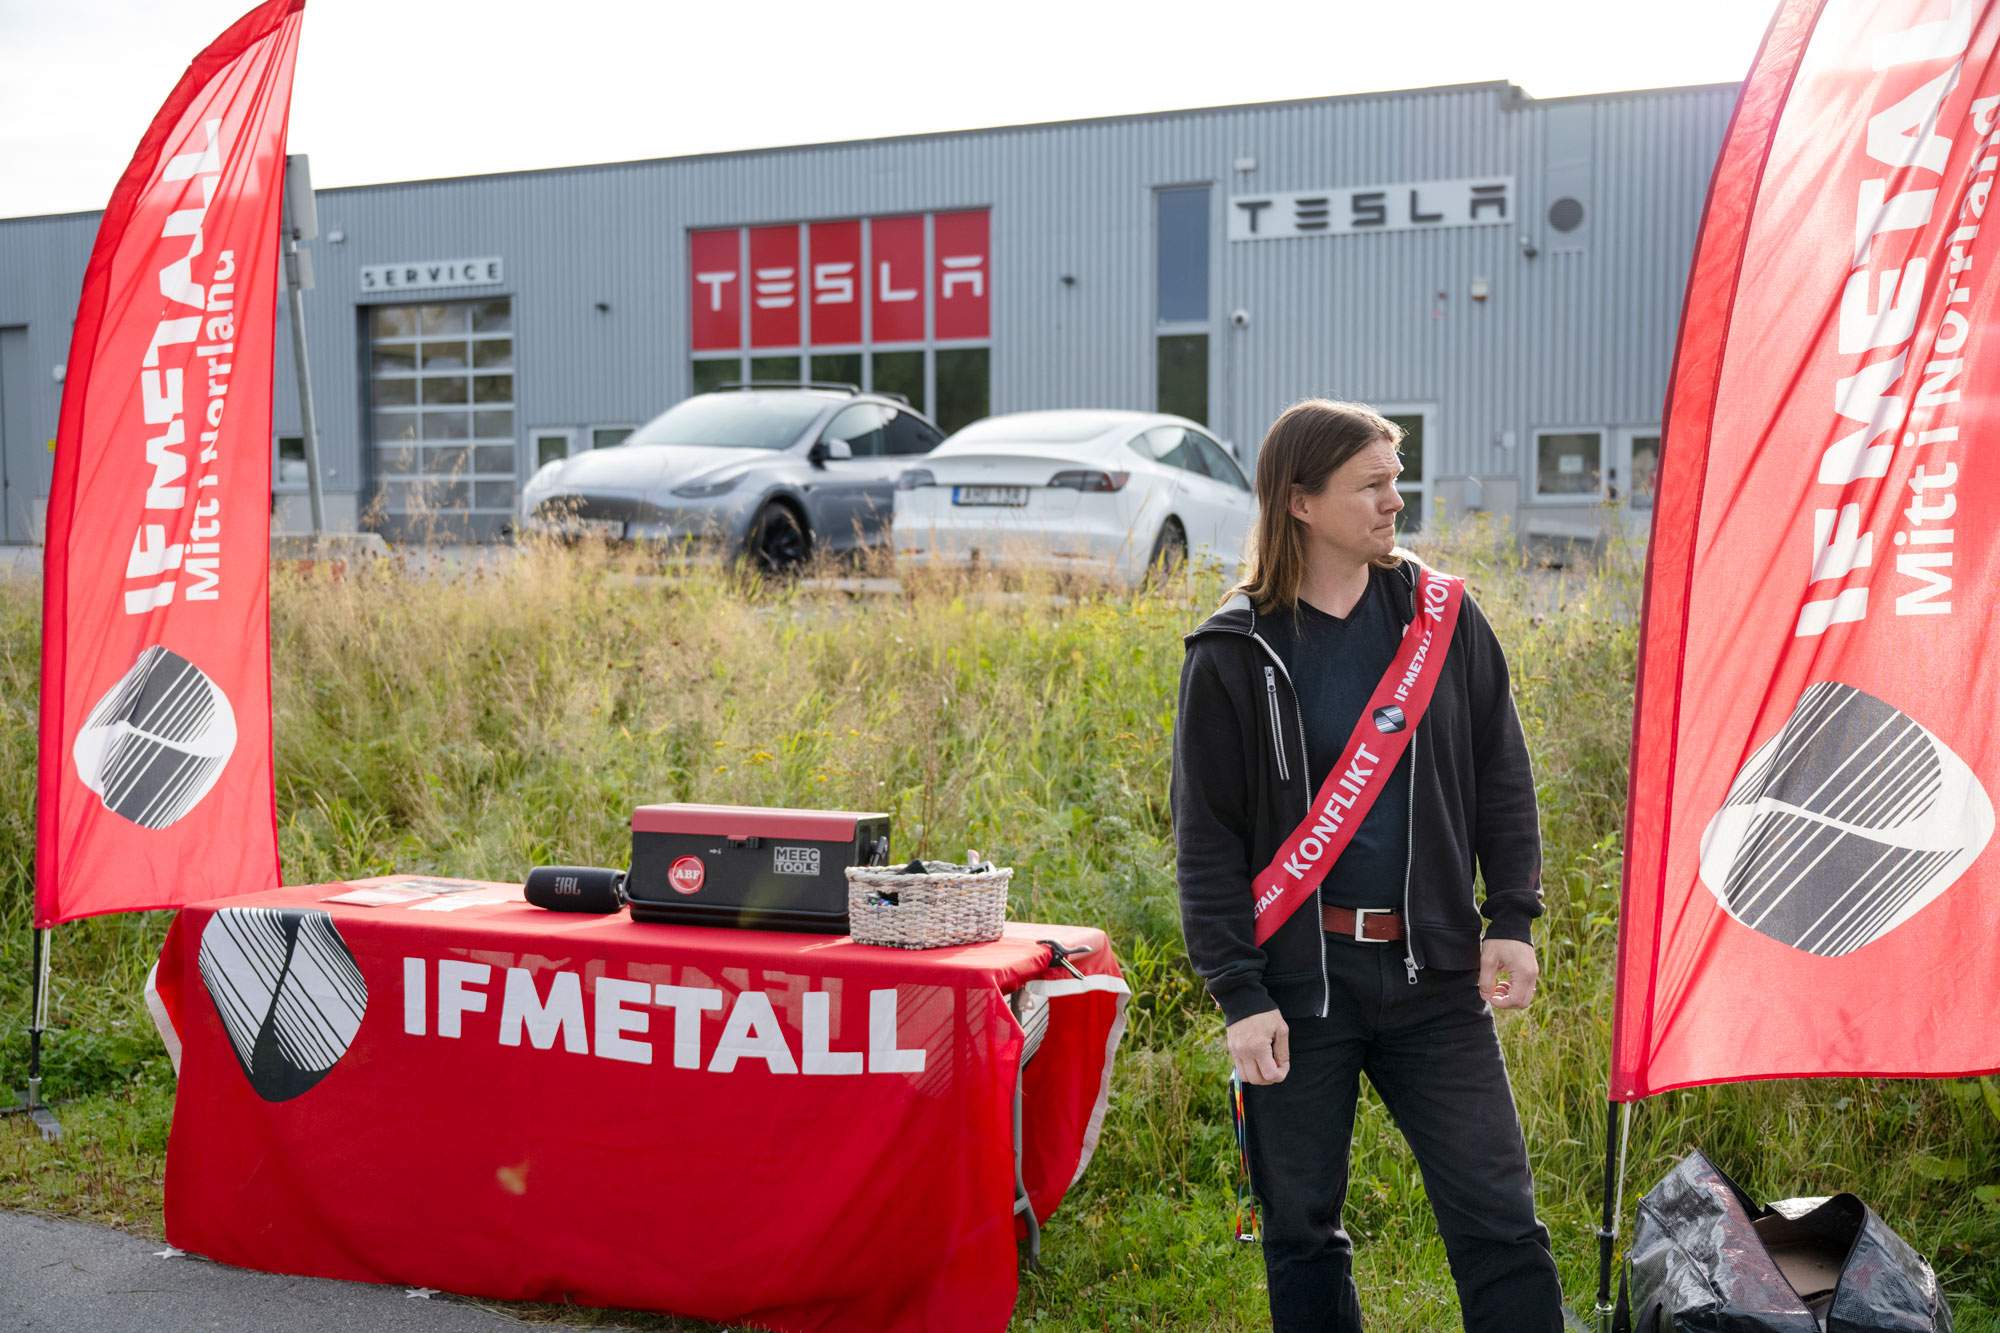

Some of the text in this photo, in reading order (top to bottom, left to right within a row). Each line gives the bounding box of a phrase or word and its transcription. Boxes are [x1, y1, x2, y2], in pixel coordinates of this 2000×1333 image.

[1236, 185, 1507, 233] TESLA
[364, 263, 498, 287] SERVICE
[696, 256, 984, 311] TESLA
[125, 118, 222, 615] IFMETALL
[1893, 94, 2000, 615] Mitt i Norrland
[198, 474, 218, 488] i
[184, 498, 220, 601] Mitt
[1394, 629, 1433, 702] IFMETALL
[1283, 743, 1380, 880] KONFLIKT
[676, 869, 700, 880] ABF
[776, 848, 818, 862] MEEC
[776, 862, 818, 874] TOOLS
[555, 877, 581, 895] JBL
[404, 957, 926, 1075] IFMETALL
